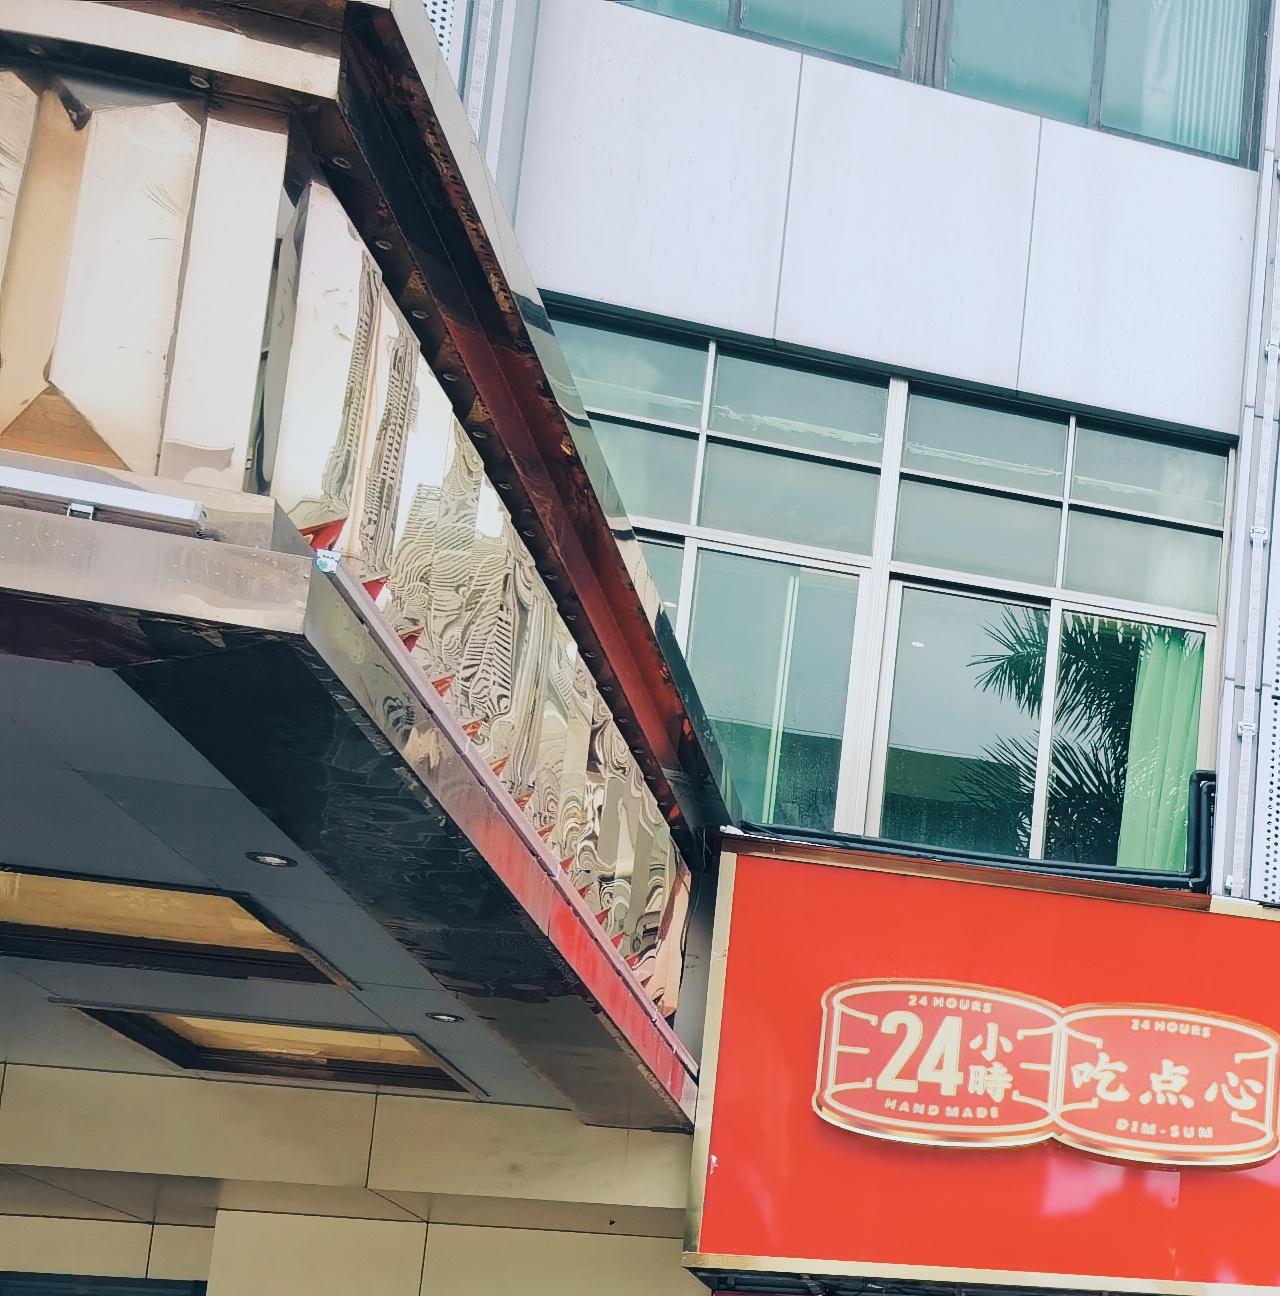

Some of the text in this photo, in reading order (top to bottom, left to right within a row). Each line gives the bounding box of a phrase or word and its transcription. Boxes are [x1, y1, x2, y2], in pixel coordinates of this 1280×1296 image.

[908, 995, 993, 1014] 24 HOURS
[1131, 1019, 1211, 1038] 24 HOURS
[1071, 1053, 1265, 1111] 吃点心
